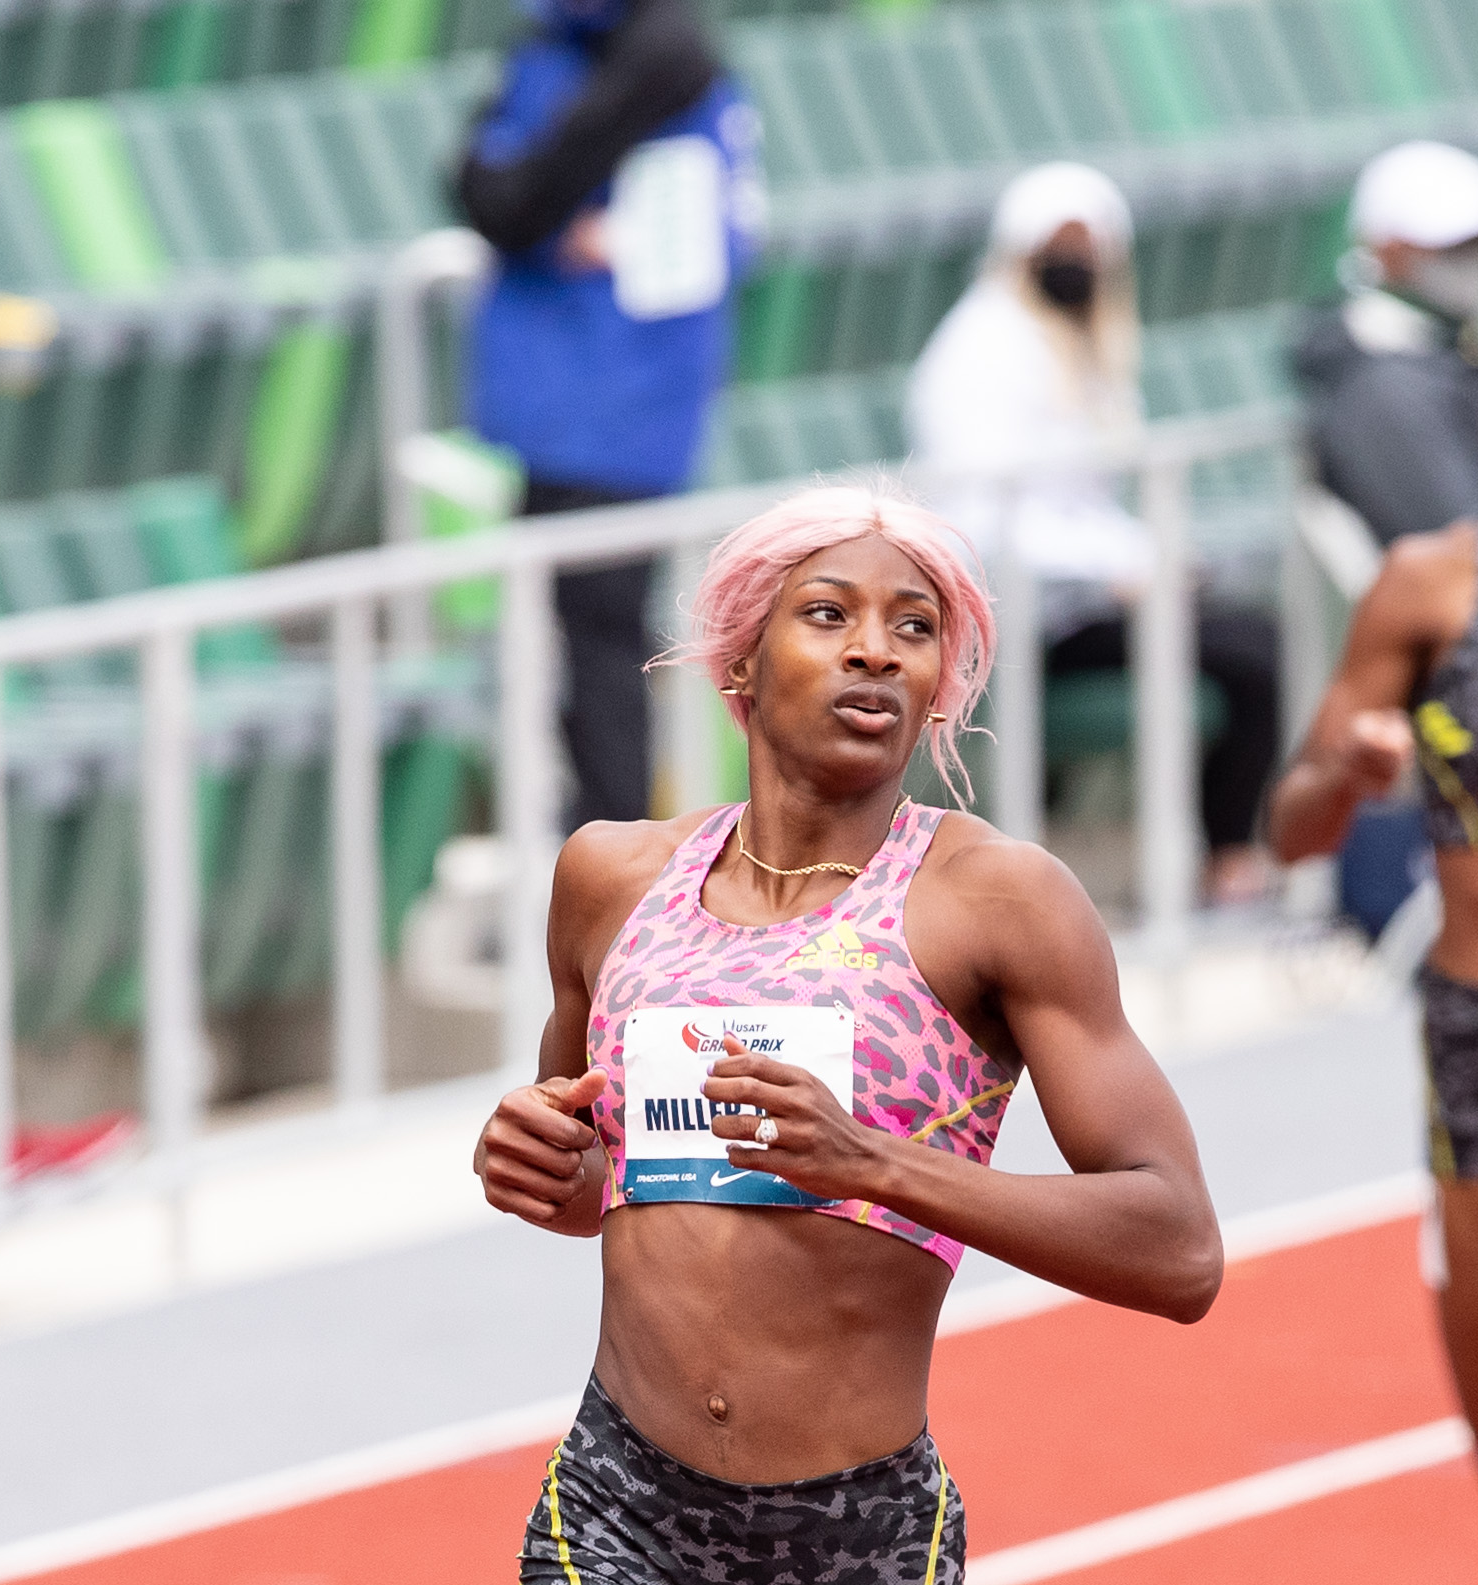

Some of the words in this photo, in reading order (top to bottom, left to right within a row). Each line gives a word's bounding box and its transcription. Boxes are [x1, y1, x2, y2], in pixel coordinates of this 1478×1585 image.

[785, 948, 879, 970] adidas
[736, 1024, 768, 1033] USATF
[700, 1039, 747, 1052] GRA
[750, 1039, 784, 1052] PRIX
[681, 1173, 697, 1182] USA
